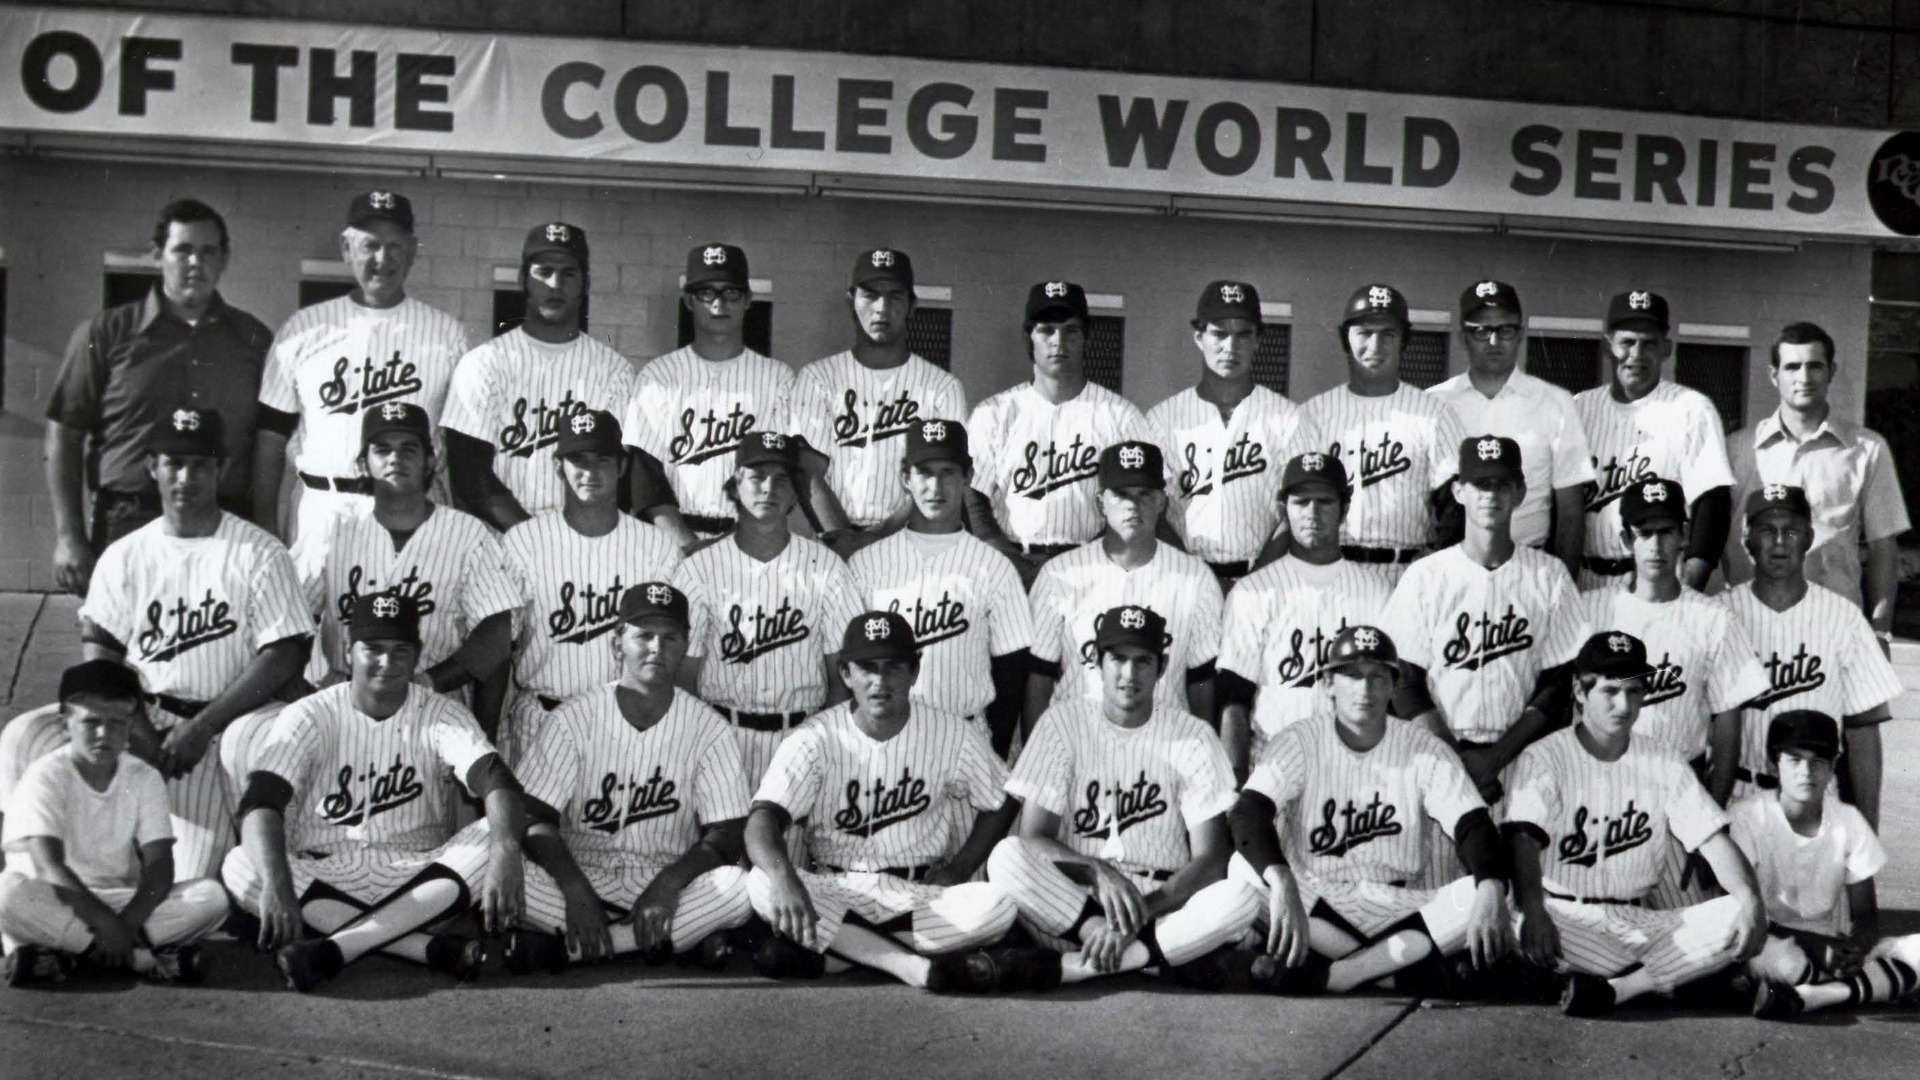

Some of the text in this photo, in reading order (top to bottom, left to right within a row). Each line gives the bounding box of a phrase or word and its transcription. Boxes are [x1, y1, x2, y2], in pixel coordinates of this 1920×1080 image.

[21, 30, 182, 115] OF
[231, 43, 455, 131] THE
[543, 62, 1049, 162] COLLEGE
[1097, 94, 1461, 188] WORLD
[1510, 124, 1837, 215] SERIES
[320, 350, 421, 414] State
[670, 402, 756, 464] State
[1013, 433, 1101, 500] State
[1181, 431, 1266, 500] Sate
[139, 589, 236, 663] State
[549, 575, 623, 645] Stat
[721, 597, 809, 665] State
[1444, 604, 1533, 670] State
[1745, 643, 1826, 711] tate
[835, 767, 930, 836] State
[1074, 771, 1168, 838] State
[1310, 792, 1401, 858] State
[1559, 800, 1653, 867] Sate
